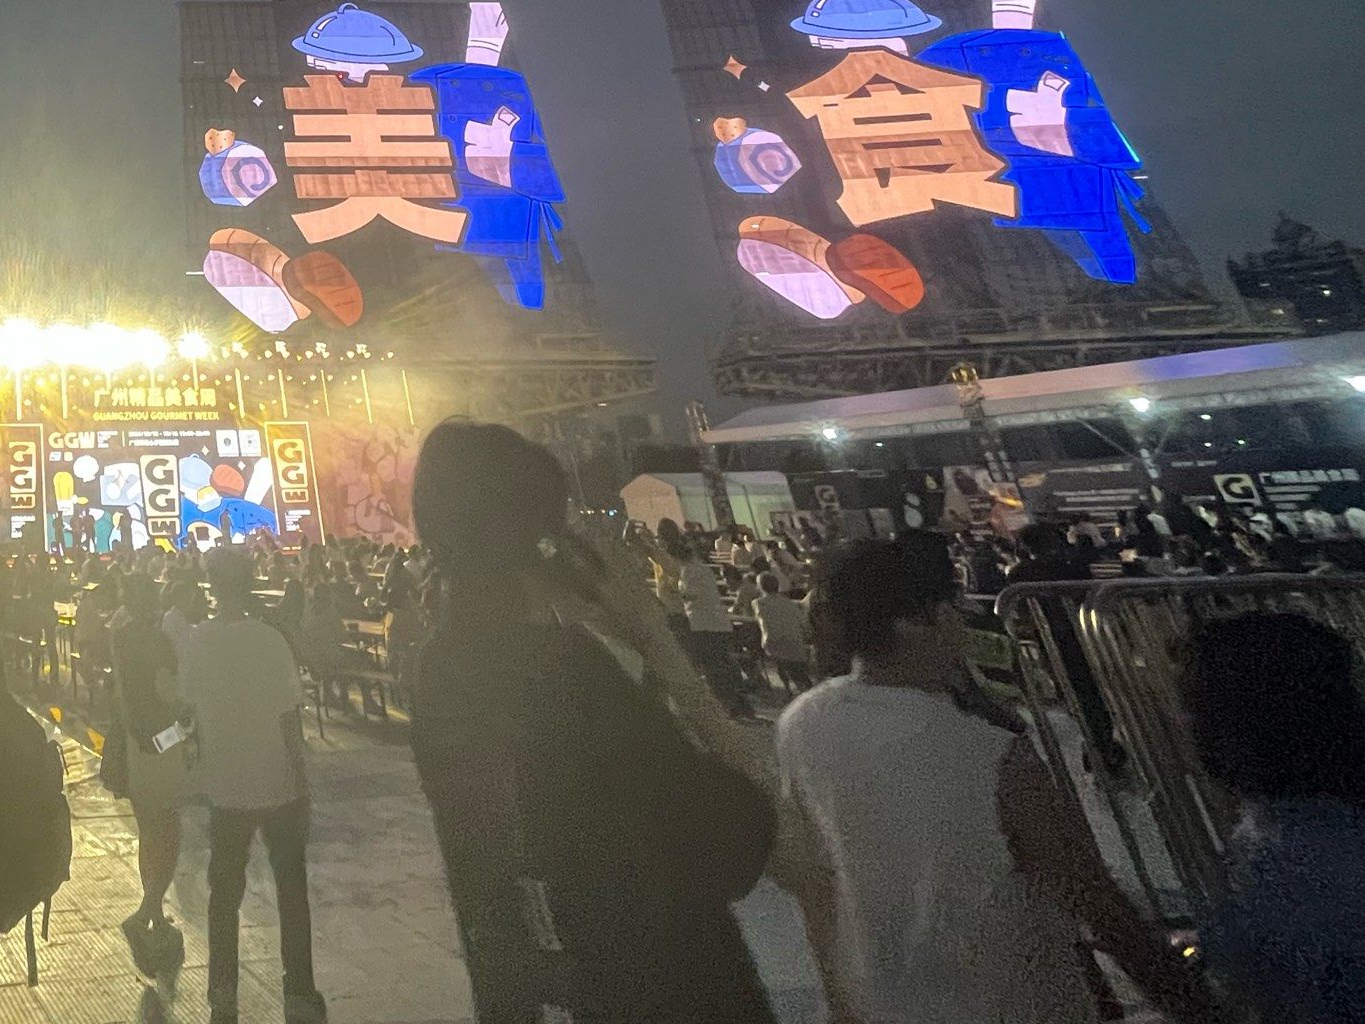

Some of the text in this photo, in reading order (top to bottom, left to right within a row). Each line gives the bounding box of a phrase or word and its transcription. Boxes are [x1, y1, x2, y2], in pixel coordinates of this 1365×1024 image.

[282, 74, 468, 244] 美
[786, 48, 1019, 228] 食
[48, 431, 95, 449] GGW
[92, 411, 220, 421] GUANGZHOU GOURMET WEEK
